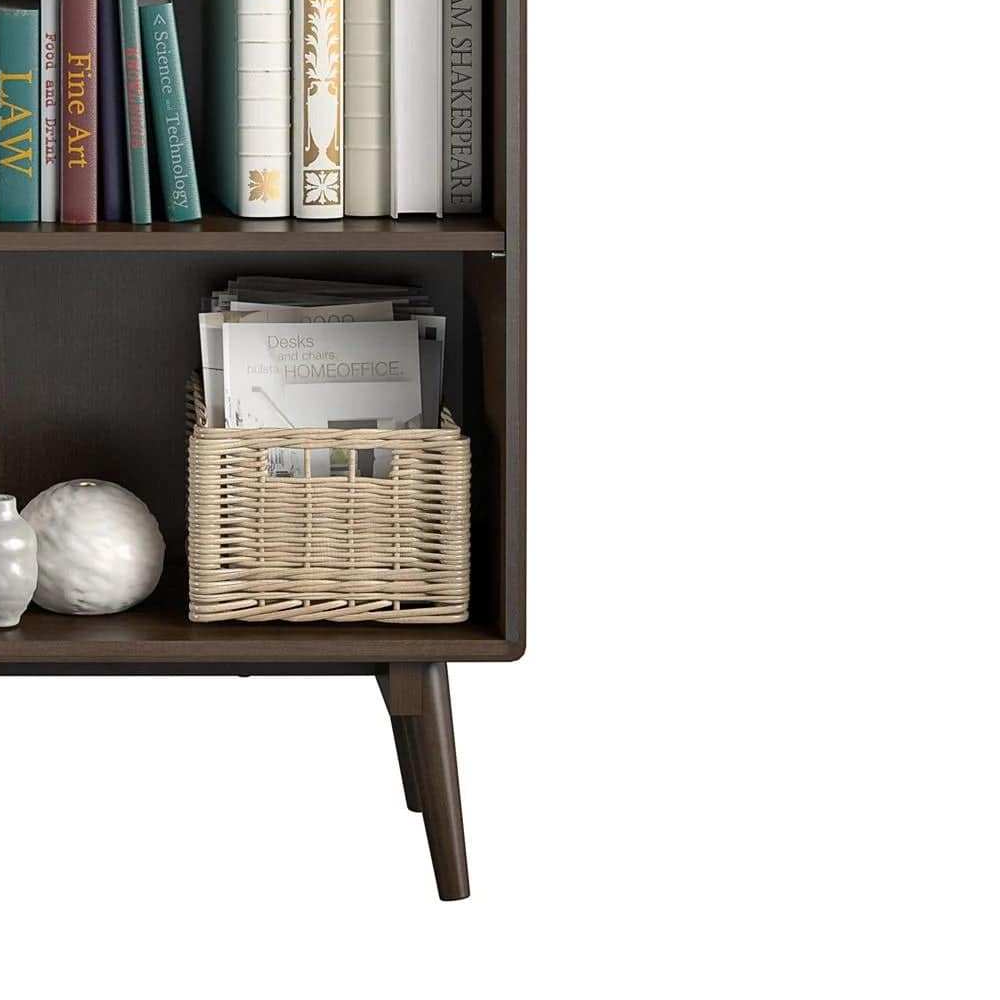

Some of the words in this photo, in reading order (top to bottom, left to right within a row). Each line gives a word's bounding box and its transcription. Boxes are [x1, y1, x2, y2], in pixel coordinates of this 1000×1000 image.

[45, 33, 57, 69] Food
[45, 80, 57, 107] and
[67, 52, 92, 115] Fine
[0, 70, 33, 178] LAW
[45, 118, 57, 164] Drink
[153, 31, 173, 95] Science
[164, 111, 189, 209] Technology
[449, 37, 473, 205] SHAKESPEARE
[67, 123, 93, 168] Art
[266, 334, 314, 350] Desks
[284, 360, 405, 379] HOMEOFFICE.
